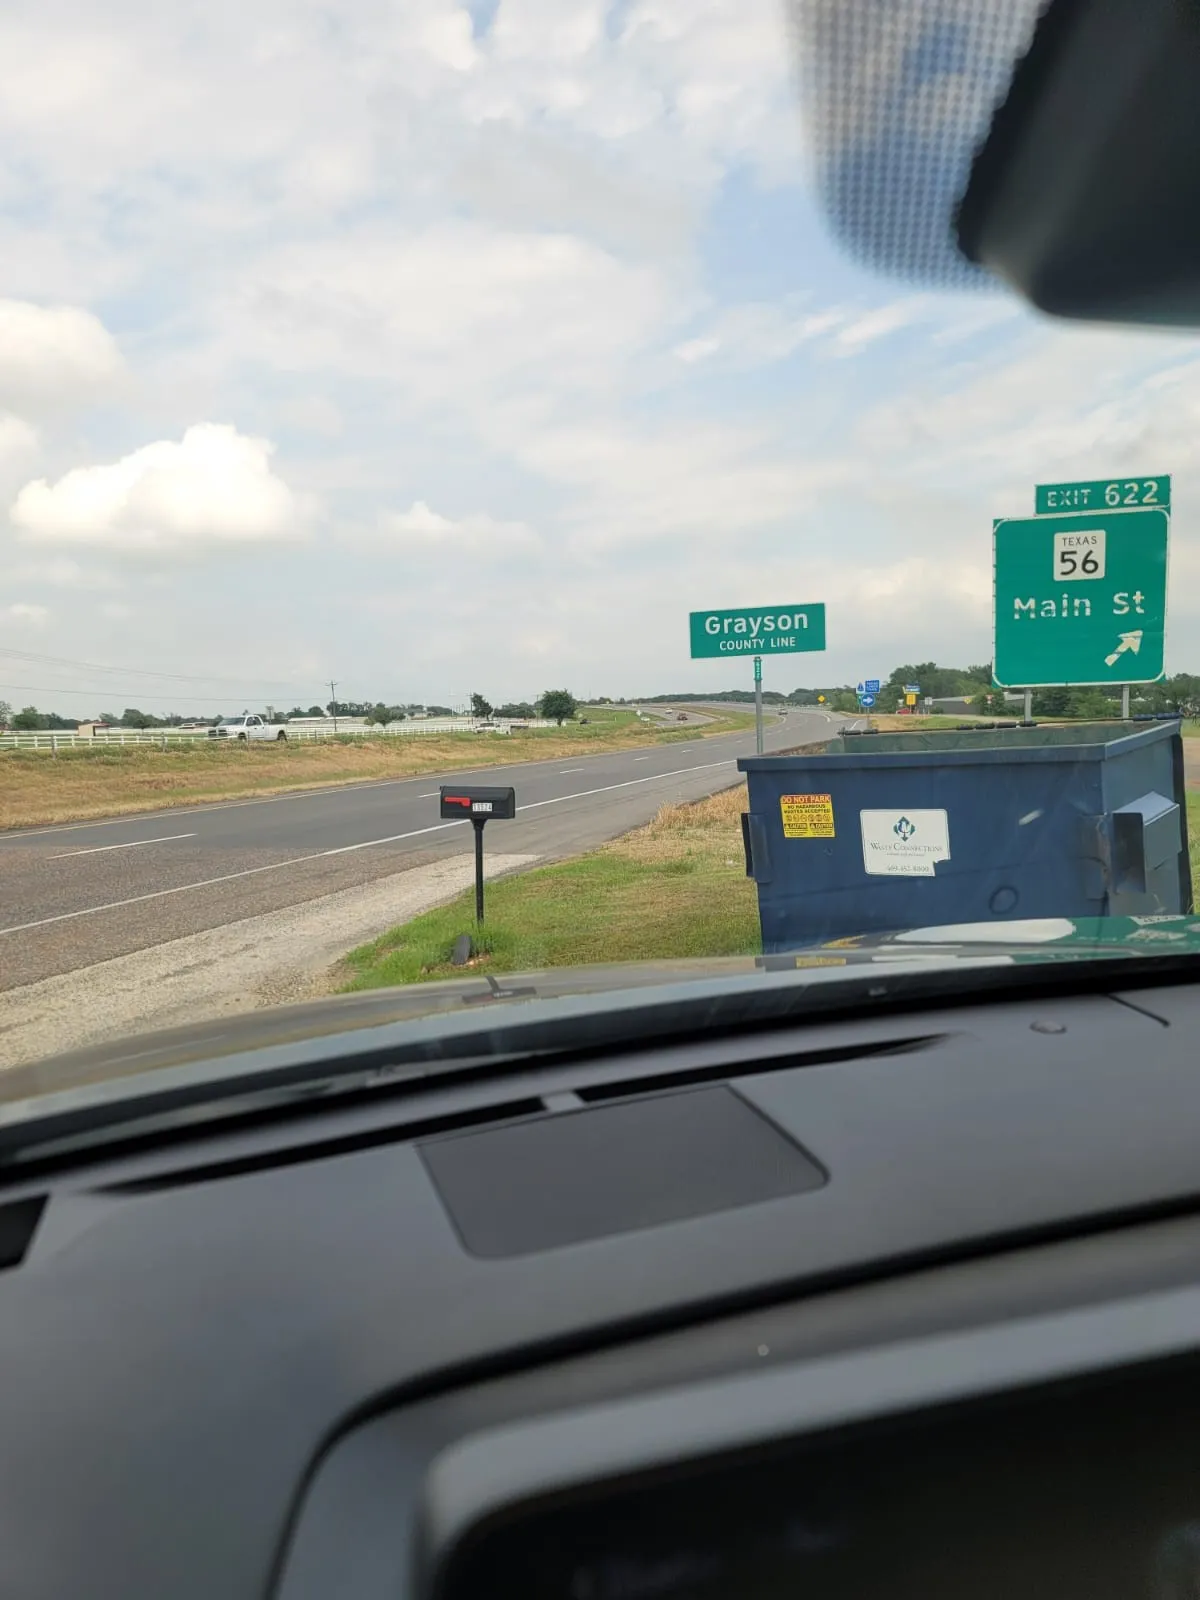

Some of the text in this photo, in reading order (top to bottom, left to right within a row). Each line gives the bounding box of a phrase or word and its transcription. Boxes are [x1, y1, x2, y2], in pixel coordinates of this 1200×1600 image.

[1047, 480, 1159, 507] EXIT 622
[1062, 535, 1098, 547] TEXAS
[1060, 550, 1099, 576] 56
[1013, 590, 1145, 620] Main St
[705, 612, 808, 638] Grayson
[719, 636, 796, 651] COUNTY LINE
[793, 796, 808, 804] NOT
[810, 795, 830, 803] PARK
